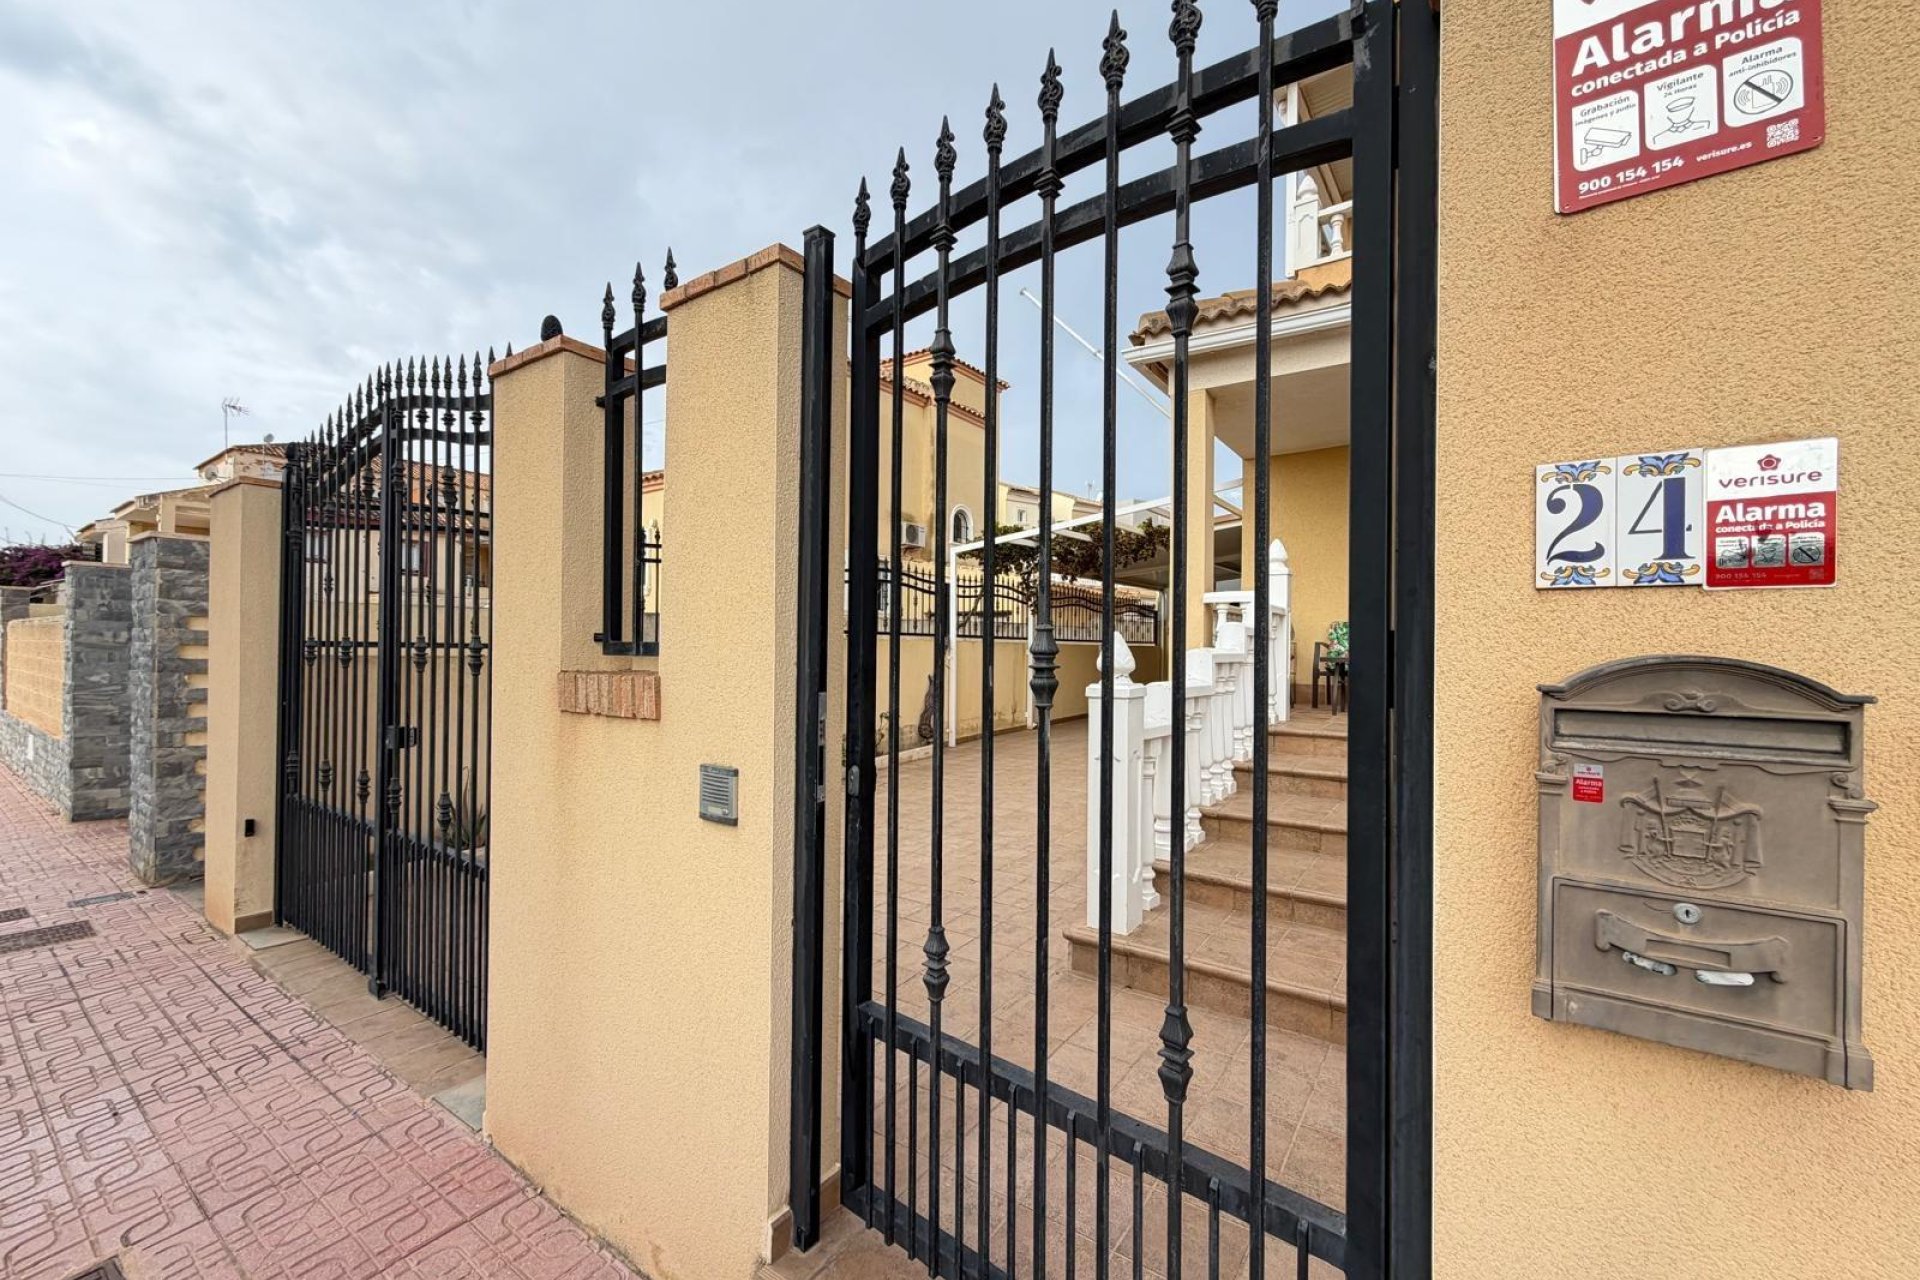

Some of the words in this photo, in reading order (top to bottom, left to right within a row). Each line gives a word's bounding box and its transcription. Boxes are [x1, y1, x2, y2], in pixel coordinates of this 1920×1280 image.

[1571, 0, 1796, 78] Alarm
[1571, 50, 1687, 97] conectada
[1693, 42, 1708, 56] a
[1715, 9, 1801, 50] Policía
[1741, 46, 1783, 64] Alarma
[1656, 72, 1704, 92] Vigilante
[1580, 96, 1630, 118] Grabación
[1696, 141, 1753, 162] verisure.es
[1578, 175, 1612, 194] 900
[1615, 165, 1648, 183] 154
[1651, 156, 1685, 174] 154
[1718, 470, 1823, 489] verisure
[1715, 502, 1826, 524] Alarma
[1785, 518, 1825, 529] Policía
